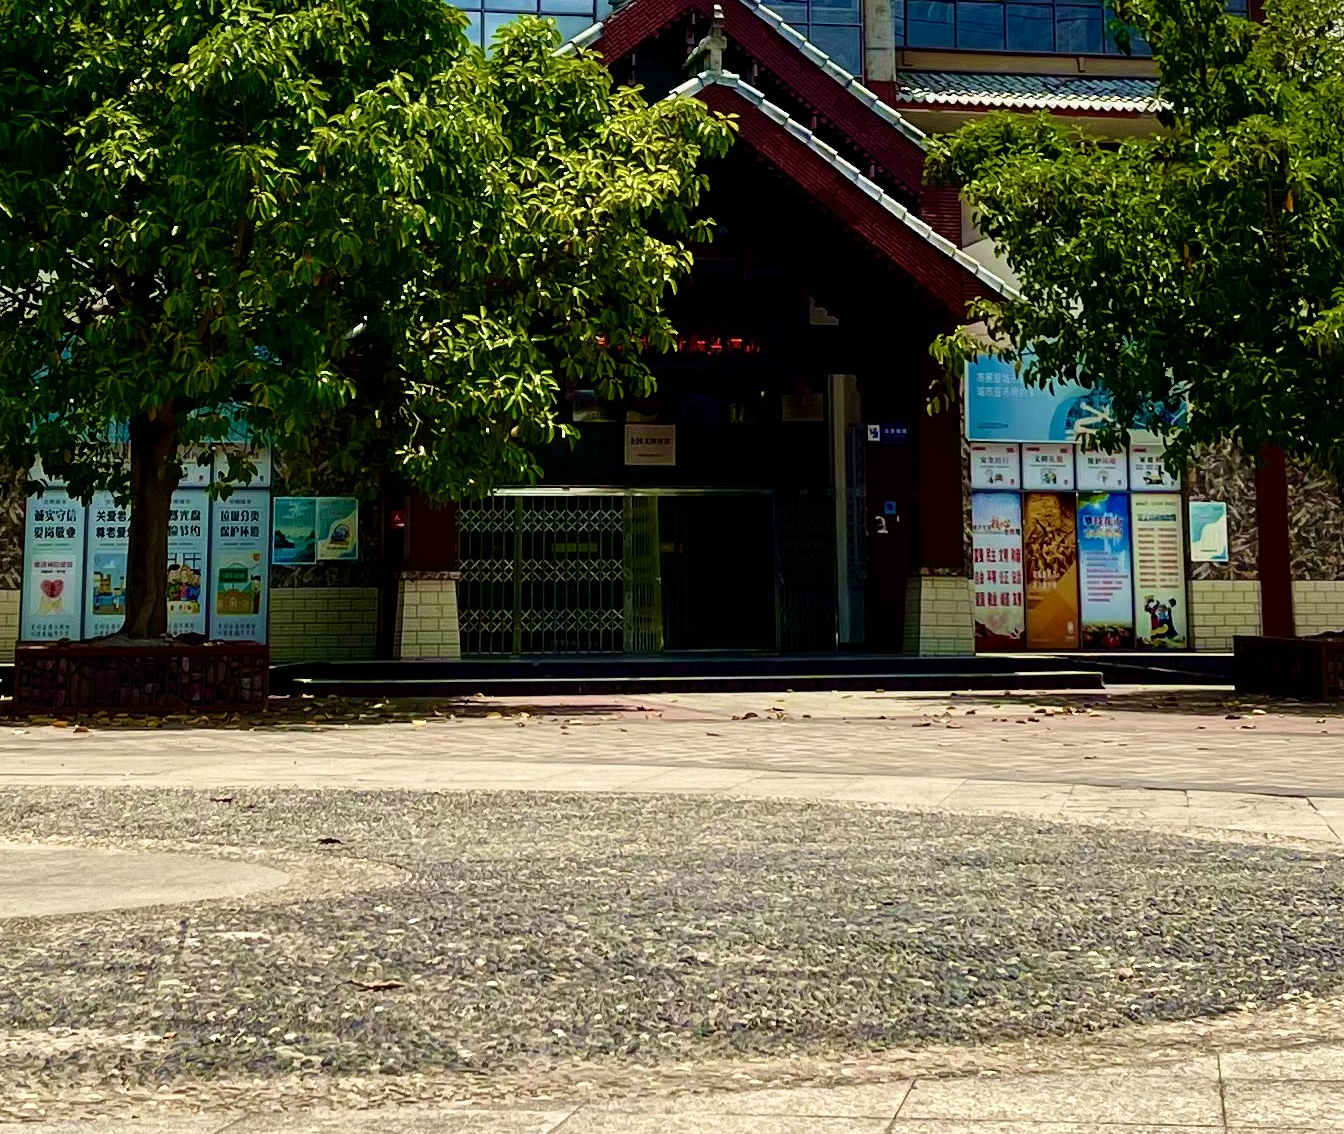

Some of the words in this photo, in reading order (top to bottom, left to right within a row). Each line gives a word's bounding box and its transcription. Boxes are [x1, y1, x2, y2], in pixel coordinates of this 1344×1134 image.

[34, 509, 77, 522] 诚实守信
[220, 510, 260, 522] 垃圾分类
[34, 526, 77, 538] 爱岗敬业
[96, 526, 130, 538] 尊老爱
[220, 526, 260, 537] 保护环境
